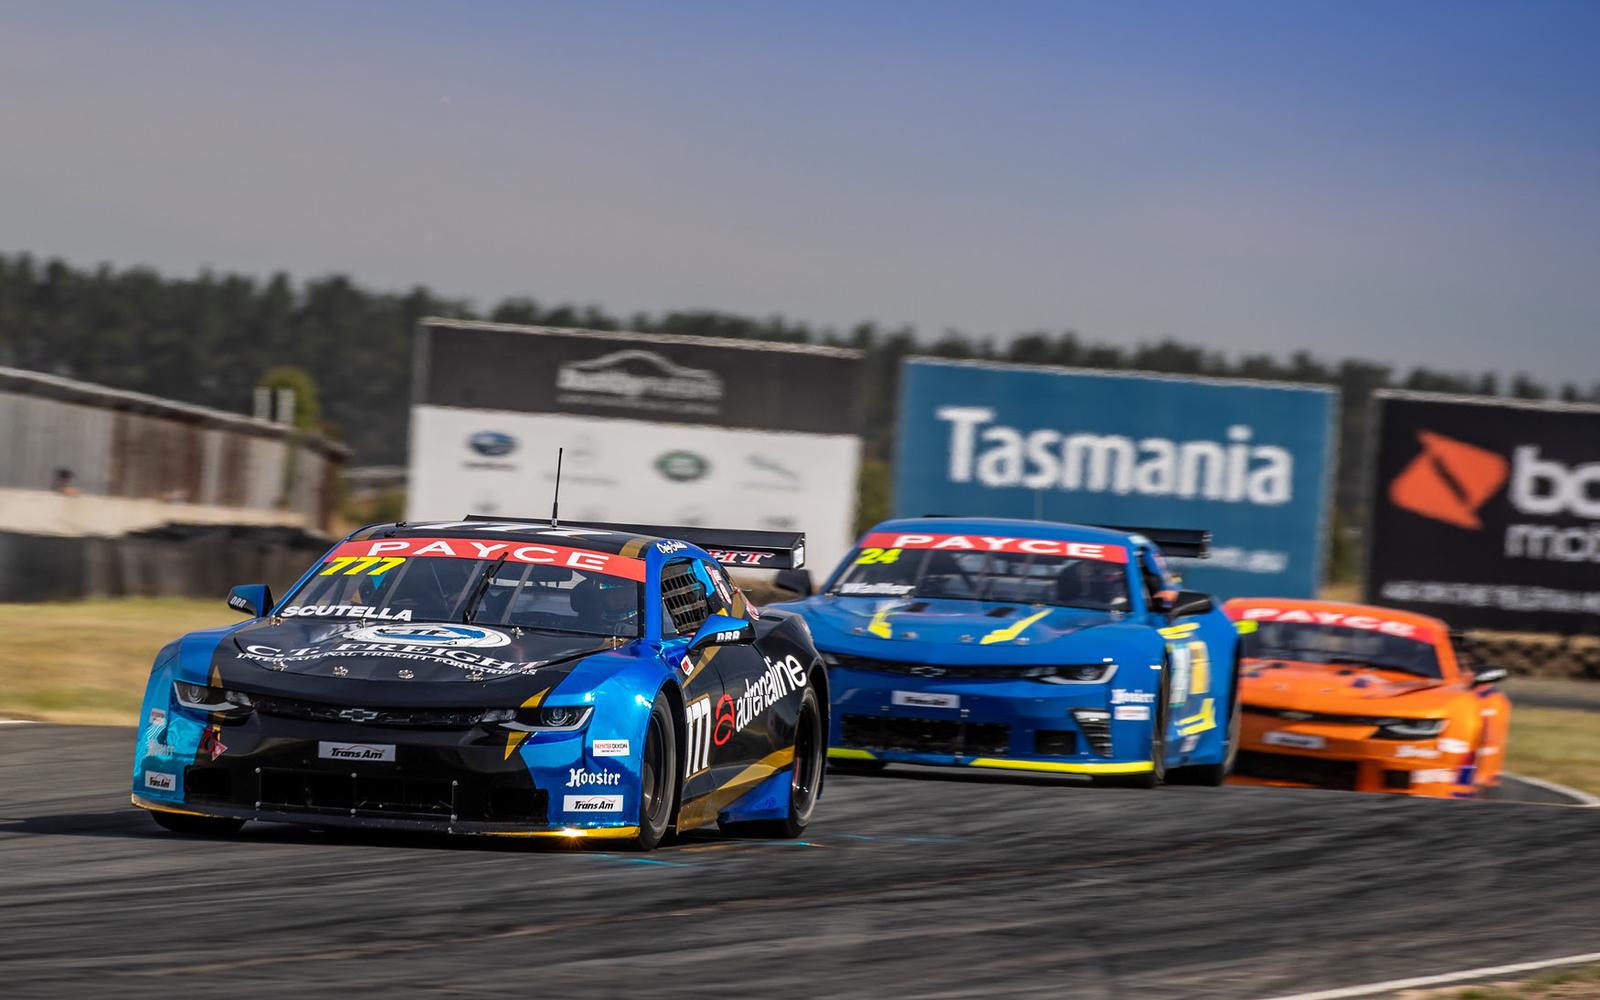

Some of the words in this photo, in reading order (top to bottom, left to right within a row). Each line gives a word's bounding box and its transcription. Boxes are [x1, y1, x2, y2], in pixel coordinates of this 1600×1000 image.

[936, 405, 1294, 506] Tasmania
[368, 540, 610, 571] PAYCE
[855, 547, 903, 565] 24
[895, 534, 1105, 560] PAYCE
[320, 556, 407, 577] 777
[280, 604, 413, 622] SCUTELLA
[1242, 607, 1417, 638] PAYCE
[333, 643, 549, 671] FREIGHT
[360, 651, 431, 661] FREIGHT
[736, 654, 807, 733] adrenaline
[330, 747, 361, 758] Trans
[362, 750, 383, 759] Am
[566, 767, 621, 788] Hoosier
[574, 801, 598, 810] Trans
[598, 801, 614, 810] Am
